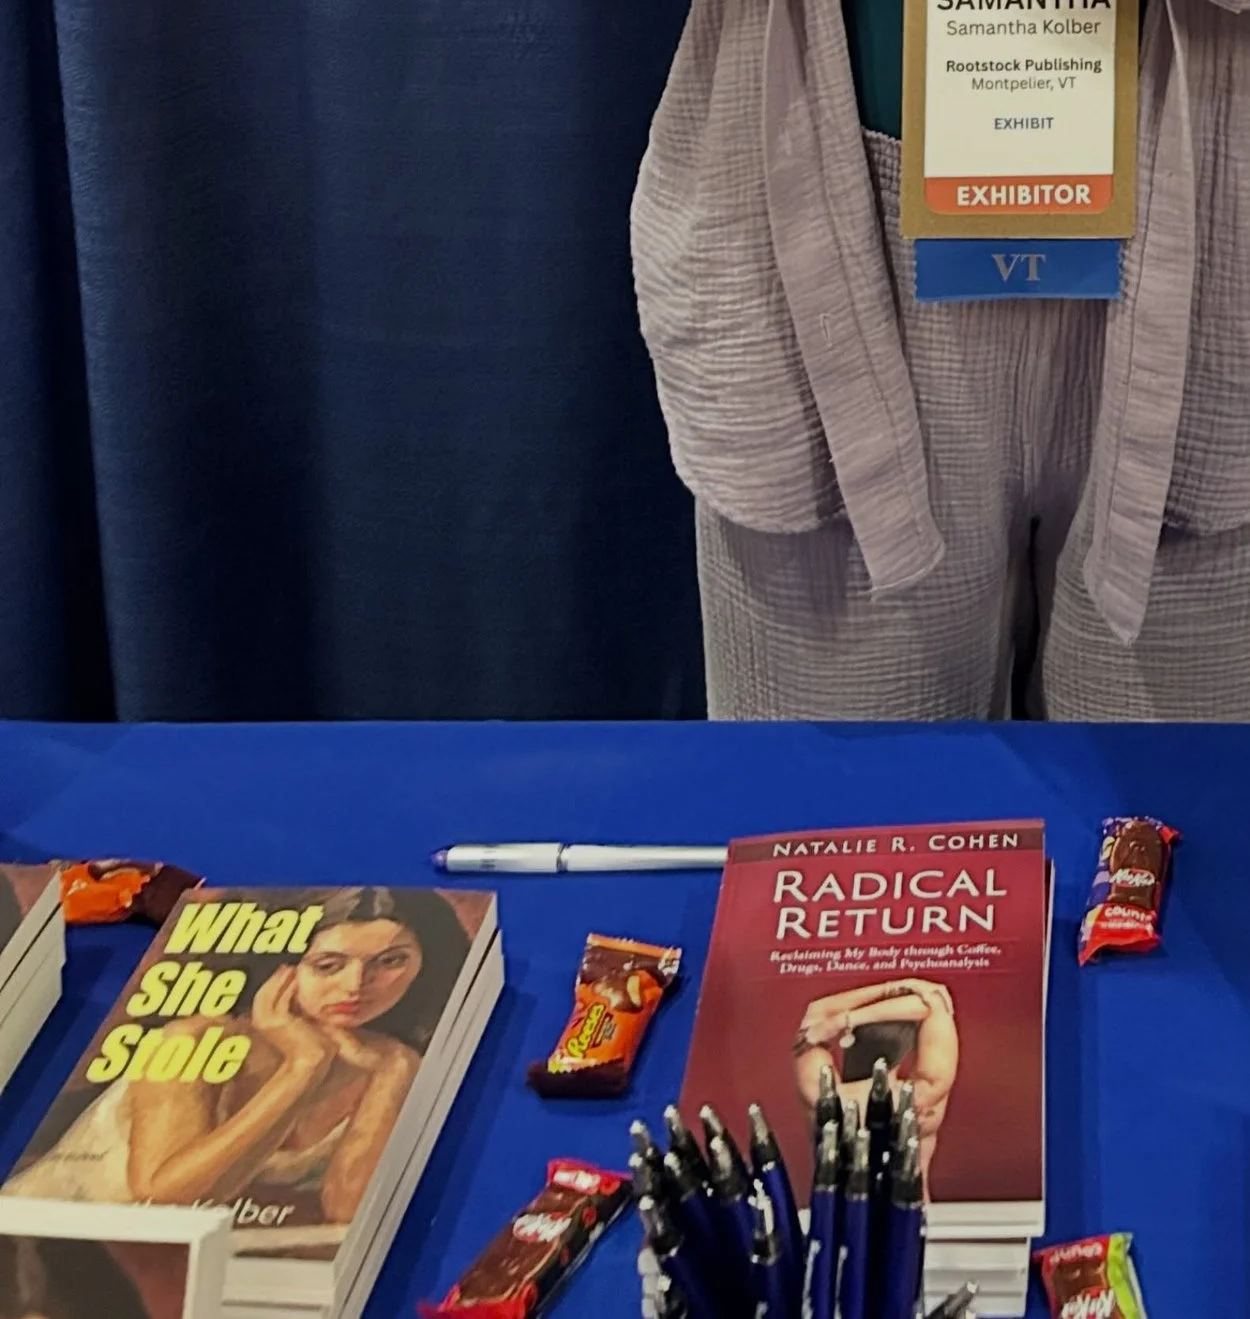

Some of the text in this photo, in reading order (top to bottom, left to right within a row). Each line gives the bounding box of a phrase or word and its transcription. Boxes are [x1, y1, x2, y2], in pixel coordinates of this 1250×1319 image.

[947, 19, 1101, 35] Samantha Kolber
[946, 58, 1102, 73] Rootstock Publishing
[972, 77, 1076, 92] Montpelier, VT
[994, 117, 1054, 130] EXHIBIT
[957, 184, 1091, 206] EXHIBITOR
[992, 254, 1046, 282] VT
[773, 833, 1018, 858] NATALIE R. COHEN
[773, 868, 1007, 903] RADICAL
[163, 902, 325, 954] What
[776, 903, 995, 940] RETURN
[868, 946, 901, 959] Body
[904, 944, 953, 958] through
[126, 960, 247, 1018] She
[86, 1023, 251, 1085] Stole
